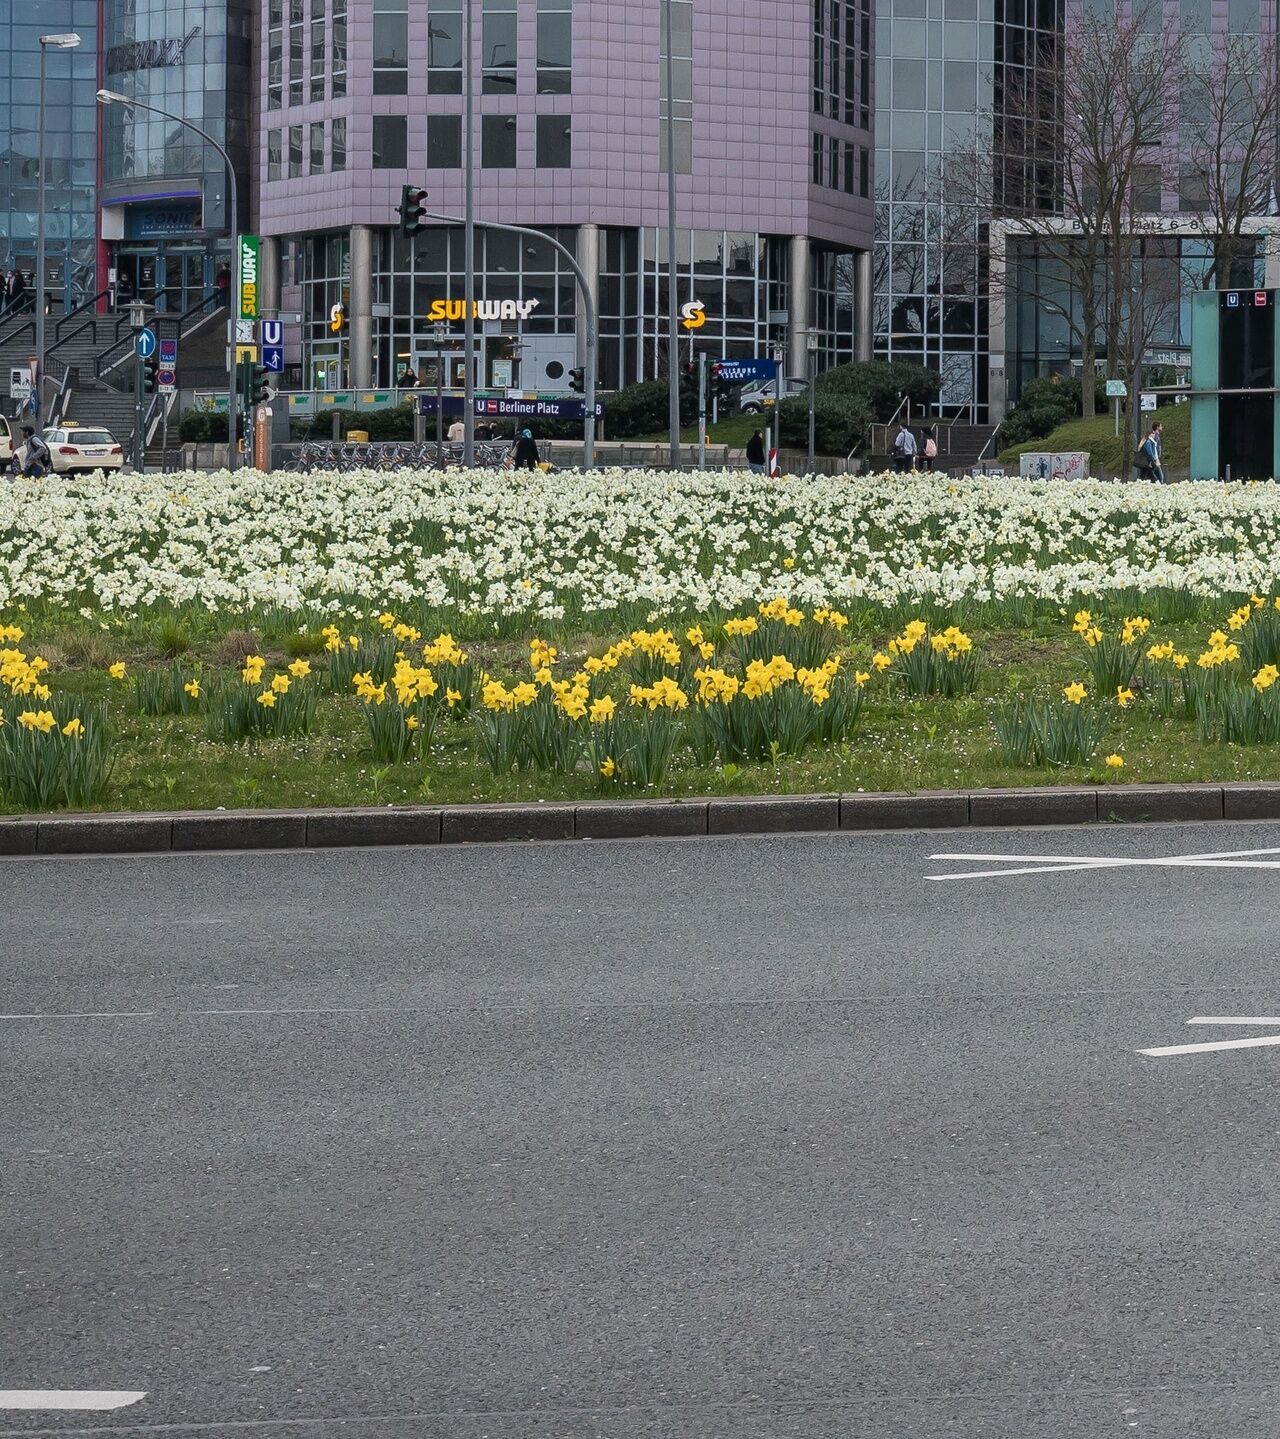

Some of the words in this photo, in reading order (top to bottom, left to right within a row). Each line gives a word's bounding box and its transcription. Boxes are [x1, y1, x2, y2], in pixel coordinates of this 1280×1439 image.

[242, 242, 257, 317] SUBWAY
[426, 297, 541, 321] SUBWAY
[265, 322, 280, 344] U
[477, 401, 485, 412] U
[500, 401, 536, 413] Berliner
[537, 402, 560, 414] Platz
